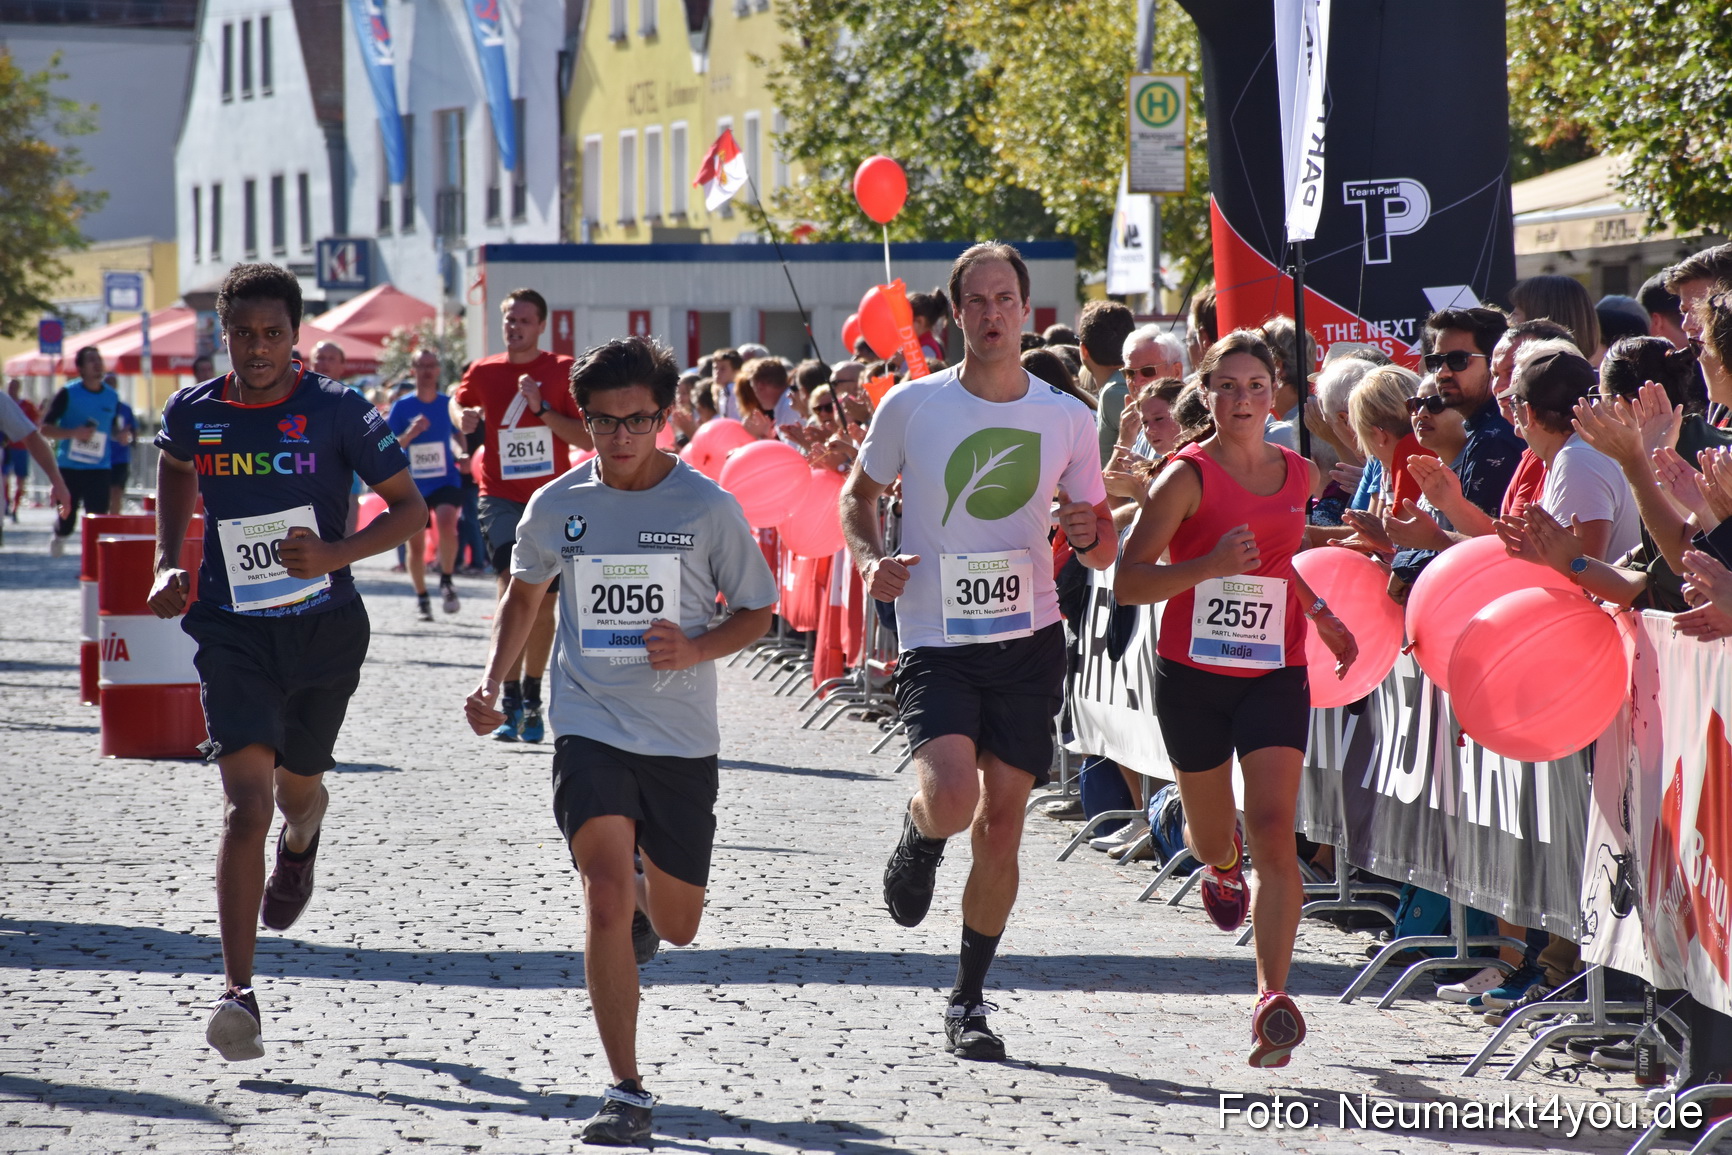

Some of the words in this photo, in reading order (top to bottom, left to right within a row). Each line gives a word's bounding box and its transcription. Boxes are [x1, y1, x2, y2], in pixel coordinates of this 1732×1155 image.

[1147, 92, 1168, 117] H
[1349, 187, 1376, 197] Team
[1377, 185, 1400, 195] Partl
[1322, 322, 1362, 342] THE
[1366, 318, 1416, 339] NEXT
[507, 440, 546, 458] 2614
[194, 452, 316, 476] MENSCH
[243, 520, 287, 536] BOCK
[639, 532, 695, 547] BOCK
[237, 538, 284, 571] 306
[561, 545, 585, 554] PARTL
[603, 564, 649, 576] BOCK
[968, 559, 1010, 571] BOCK
[247, 571, 269, 581] PARTL
[268, 568, 288, 579] Neuma
[956, 575, 1020, 606] 3049
[1223, 581, 1264, 595] BOCK
[591, 584, 664, 614] 2056
[984, 607, 1010, 615] Neumarkt
[1206, 598, 1273, 630] 2557
[608, 633, 645, 646] Jason
[1232, 631, 1259, 640] Neumarkt
[1221, 643, 1253, 659] Nadja
